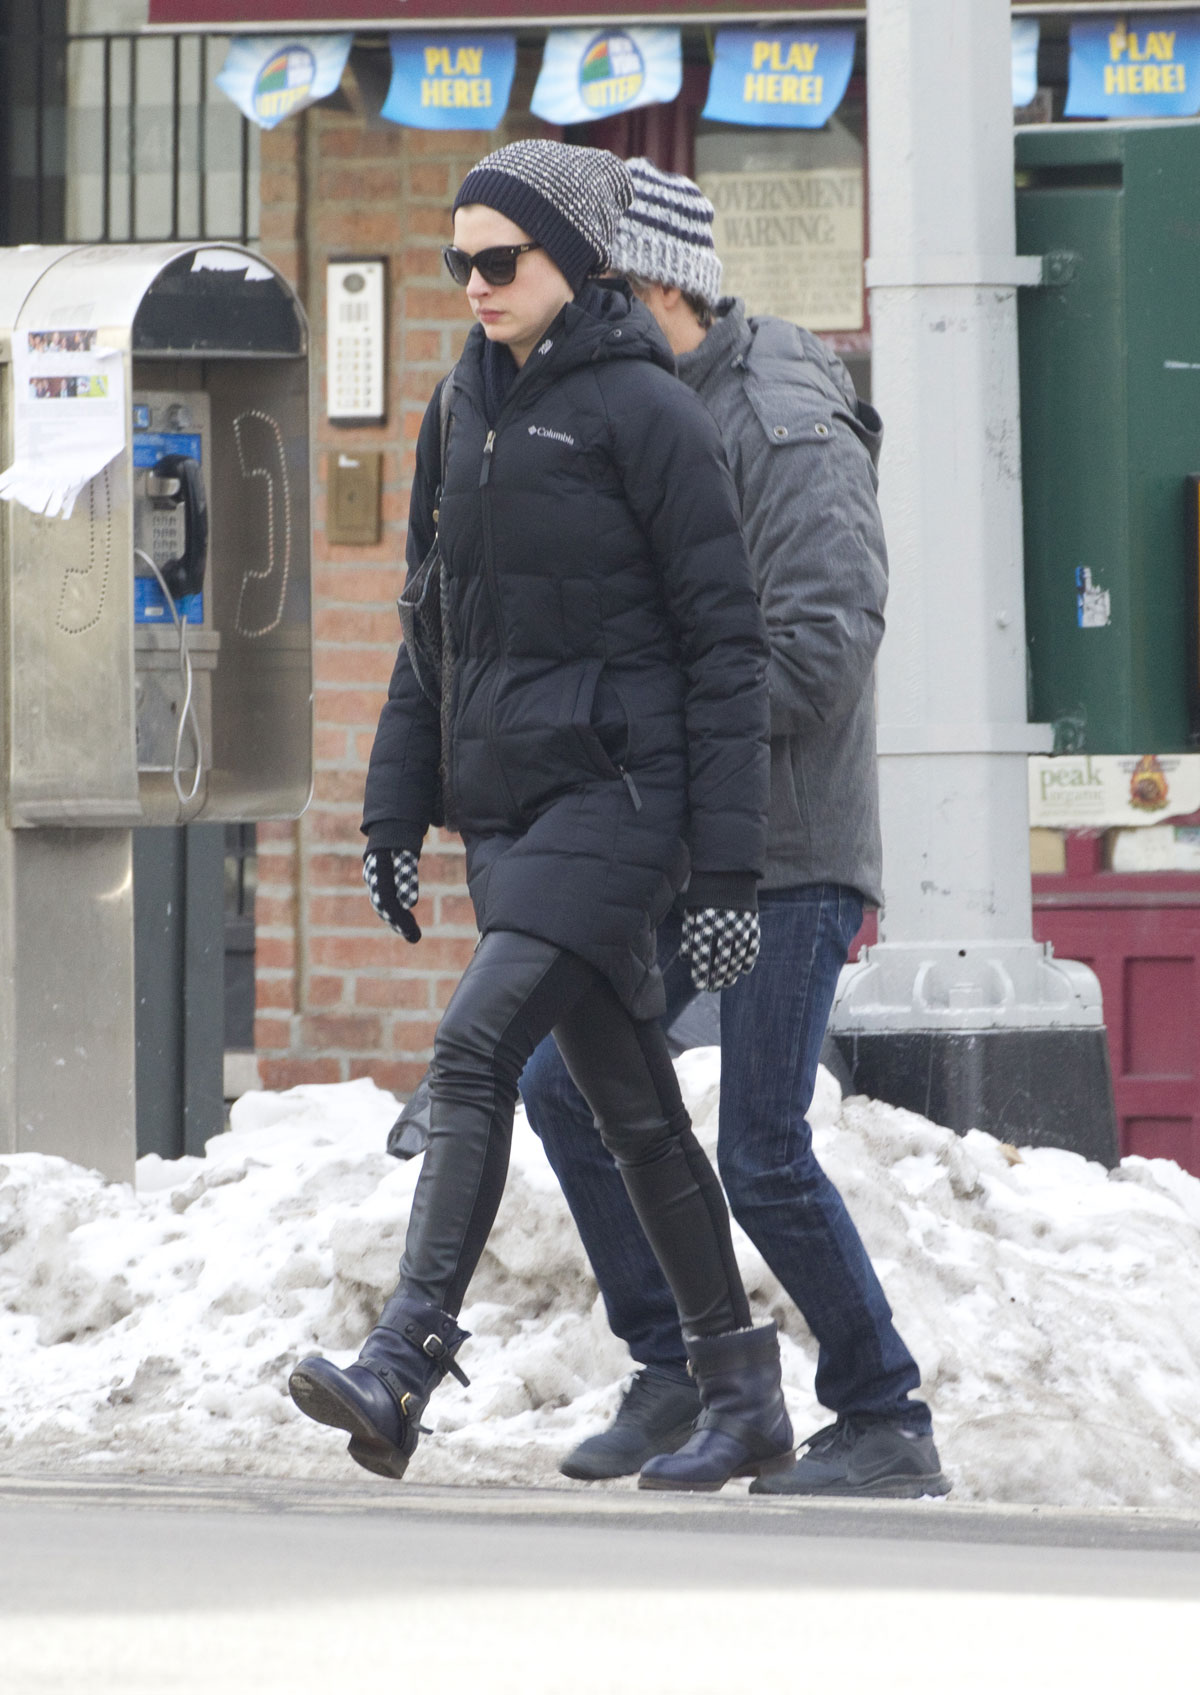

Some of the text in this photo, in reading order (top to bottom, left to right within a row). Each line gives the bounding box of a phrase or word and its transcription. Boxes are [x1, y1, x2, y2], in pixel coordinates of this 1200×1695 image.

[425, 47, 483, 75] PLAY
[752, 41, 819, 72] PLAY
[1109, 31, 1176, 62] PLAY
[421, 79, 492, 108] HERE!
[744, 73, 823, 104] HERE!
[1104, 65, 1185, 95] HERE!
[537, 426, 574, 446] Columbia
[1041, 756, 1104, 801] peak
